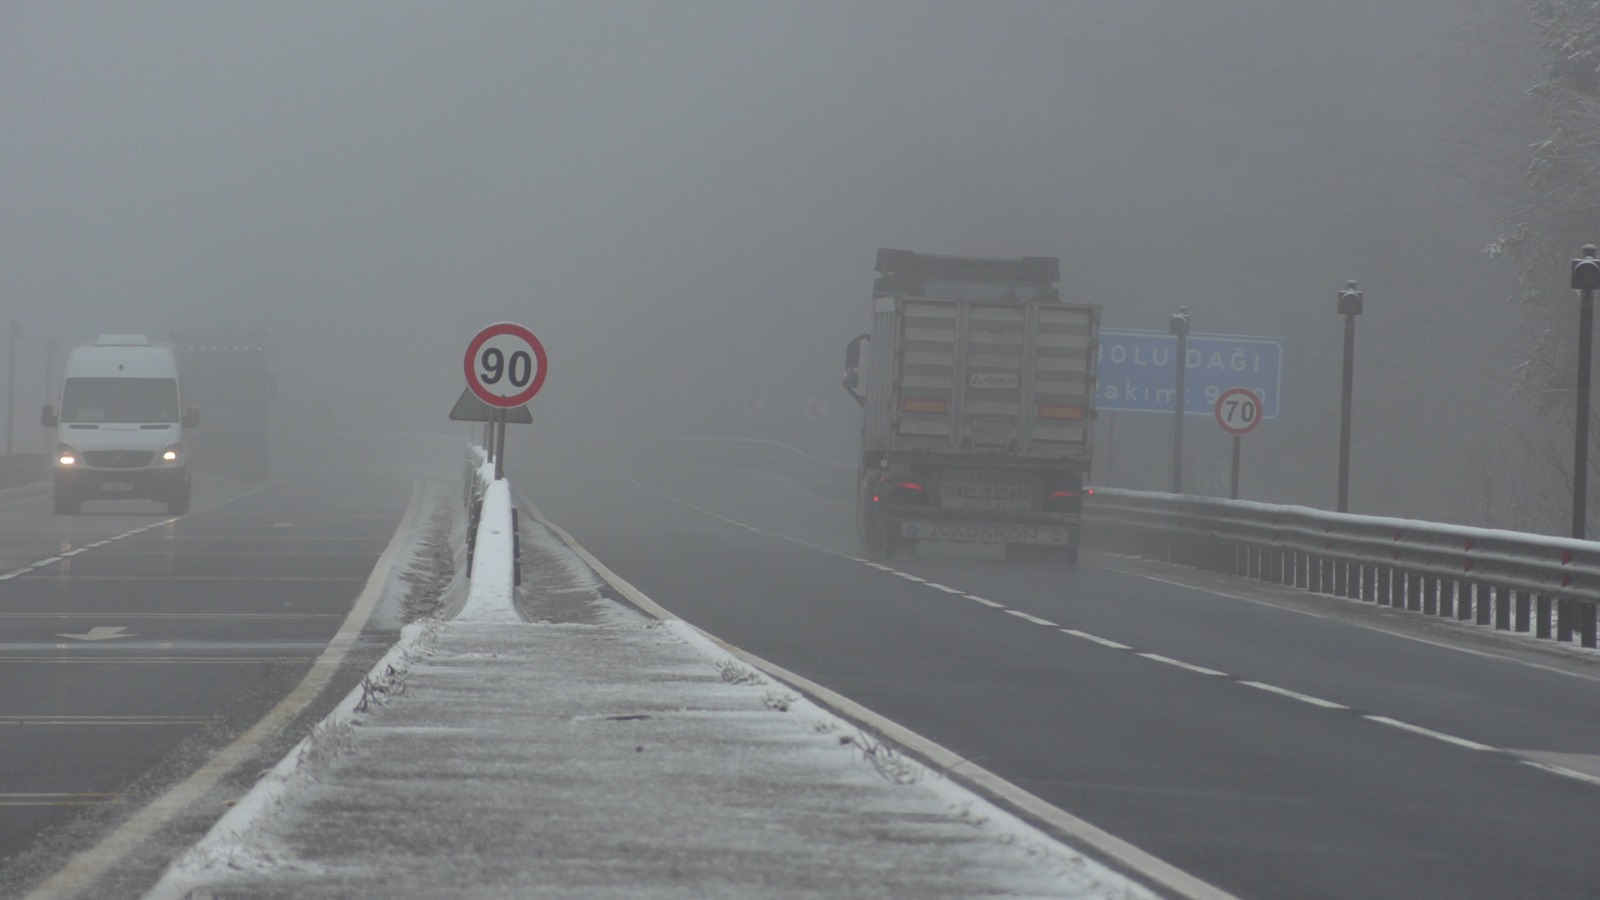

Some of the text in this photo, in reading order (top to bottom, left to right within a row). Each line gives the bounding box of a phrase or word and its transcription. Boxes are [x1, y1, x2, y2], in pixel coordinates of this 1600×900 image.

[481, 347, 532, 388] 90
[1185, 347, 1260, 372] DAĞI
[1096, 380, 1267, 405] akım: 90
[1225, 400, 1255, 422] 70
[952, 527, 1038, 541] ADAKON
